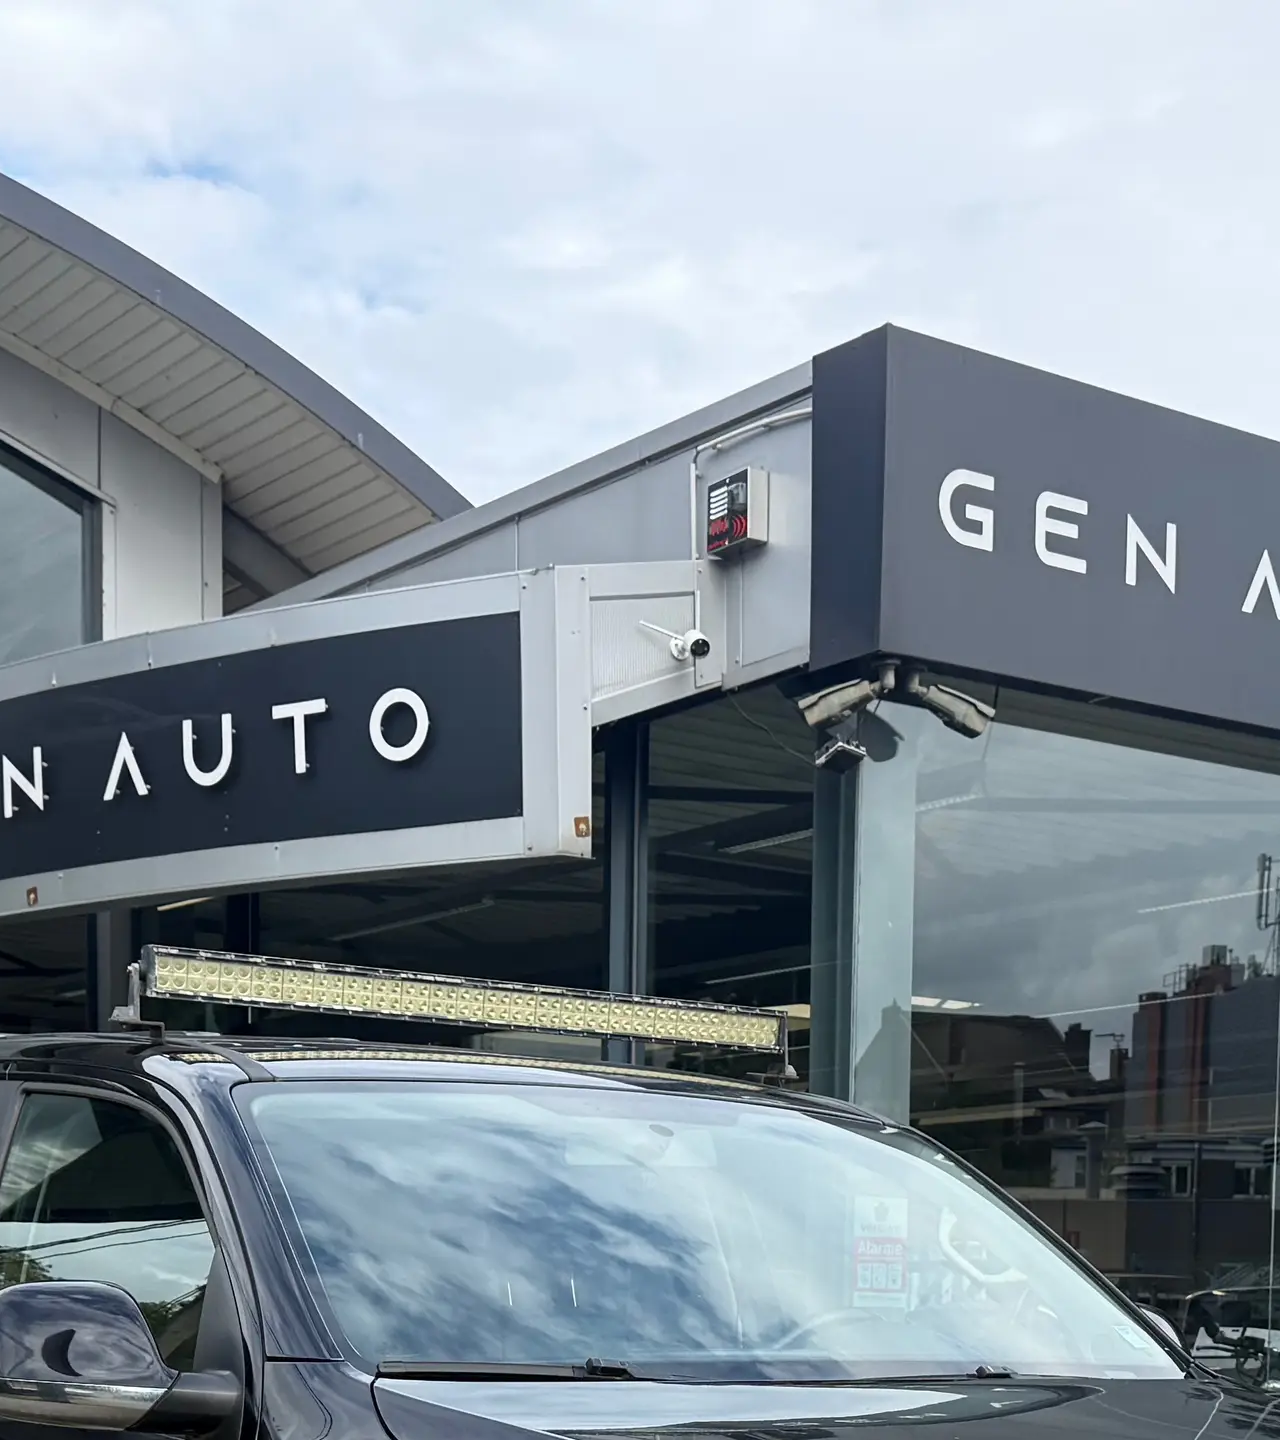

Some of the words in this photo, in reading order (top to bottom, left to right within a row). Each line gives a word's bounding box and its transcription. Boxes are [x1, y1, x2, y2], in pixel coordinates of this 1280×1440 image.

[937, 468, 1177, 594] GEN
[102, 687, 430, 802] AUTO
[857, 1239, 903, 1256] Alarme
